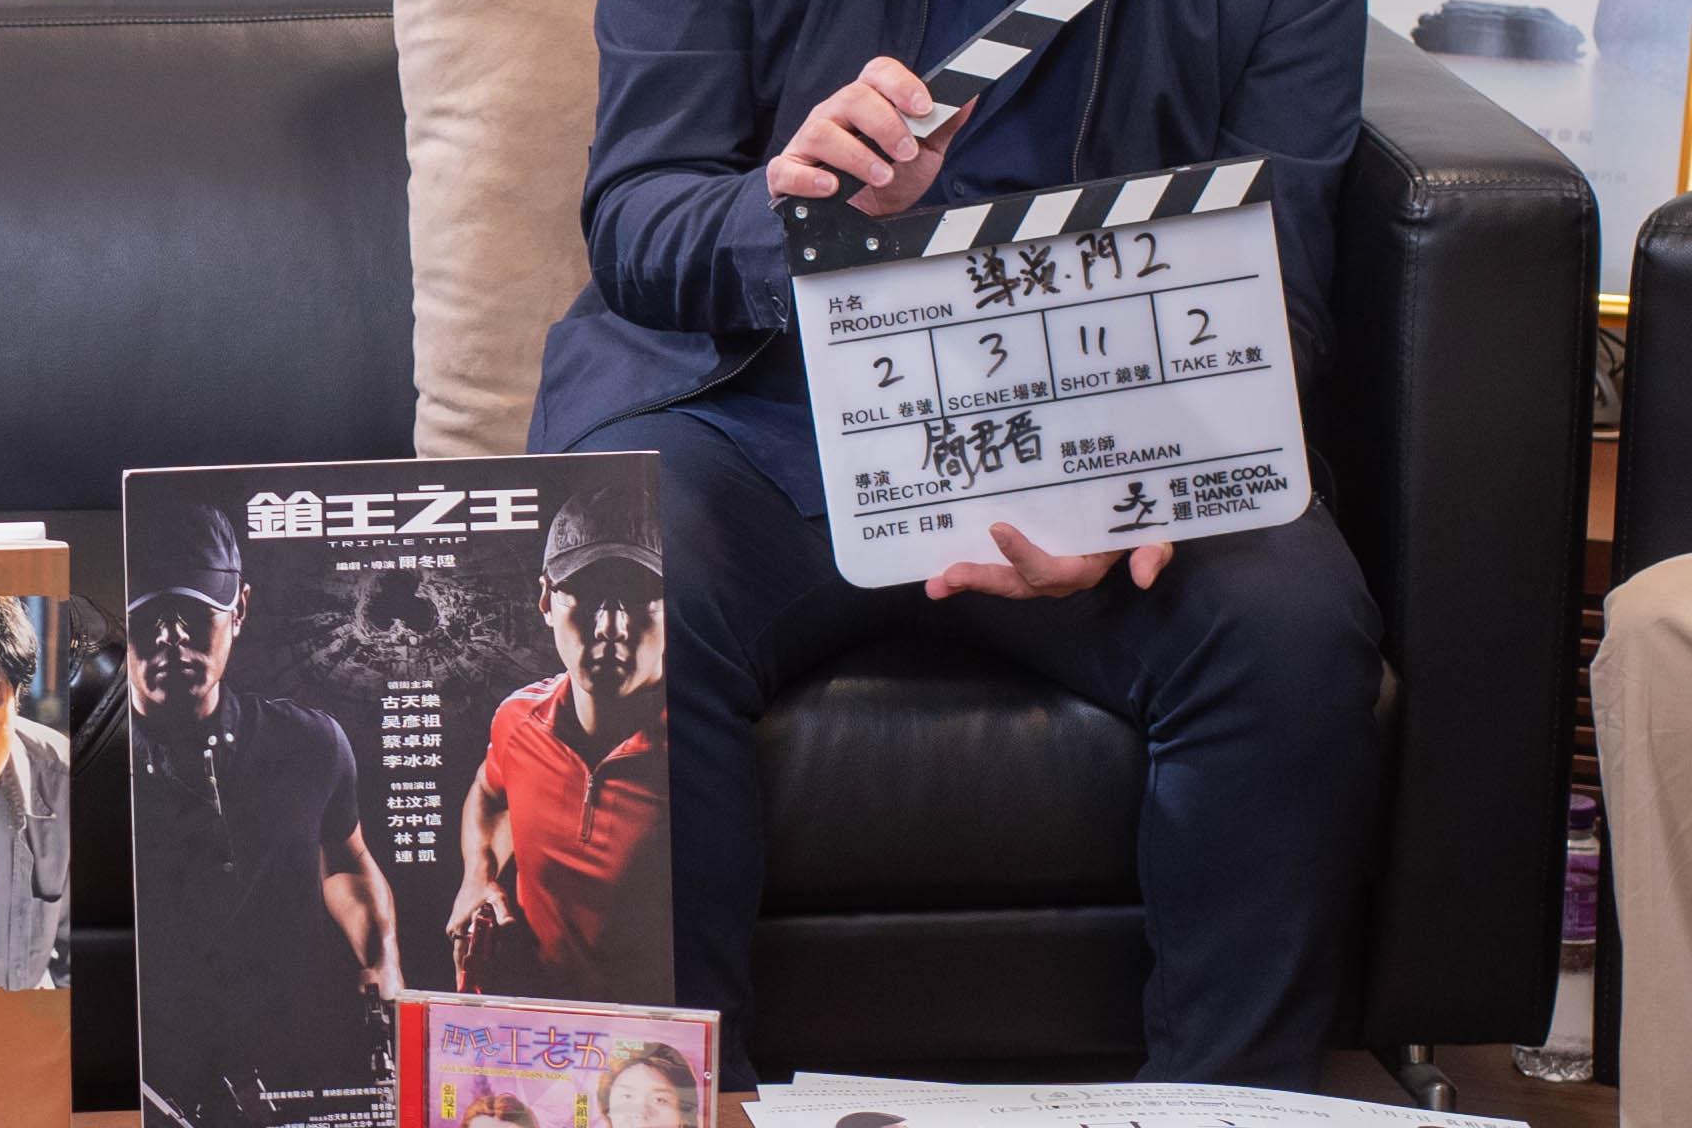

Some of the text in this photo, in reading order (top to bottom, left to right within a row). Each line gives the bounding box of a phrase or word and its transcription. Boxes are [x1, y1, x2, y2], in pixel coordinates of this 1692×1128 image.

[828, 294, 864, 314] 片名
[829, 303, 954, 336] PRODUCTION
[1187, 308, 1218, 346] 2
[978, 332, 1008, 378] 3
[1079, 325, 1107, 357] 11
[872, 356, 905, 388] 2
[1170, 345, 1264, 374] TAKE 次數
[1060, 364, 1152, 392] SHOT 鏡號
[948, 380, 1049, 411] SCENE 場號
[841, 397, 934, 426] ROLL 卷號
[1059, 435, 1116, 459] 攝影師
[1062, 443, 1182, 474] CAMERAMAN
[855, 470, 892, 490] 導演
[1192, 463, 1278, 488] ONE COOL
[1195, 476, 1289, 503] HANG WAN
[856, 479, 954, 507] DIRECTOR
[246, 484, 540, 540] 鎗王之王
[1196, 498, 1261, 519] RENTAL
[862, 513, 954, 541] DATE 日期
[326, 536, 468, 549] TRIPLE TAP
[398, 554, 457, 569] 爾冬陞
[380, 694, 441, 710] 古天樂
[382, 734, 443, 749] 蔡卓妍
[382, 753, 443, 768] 李冰冰
[386, 795, 442, 810] 杜汶澤
[387, 813, 443, 828] 方中信
[441, 1023, 610, 1070] 再見王老五
